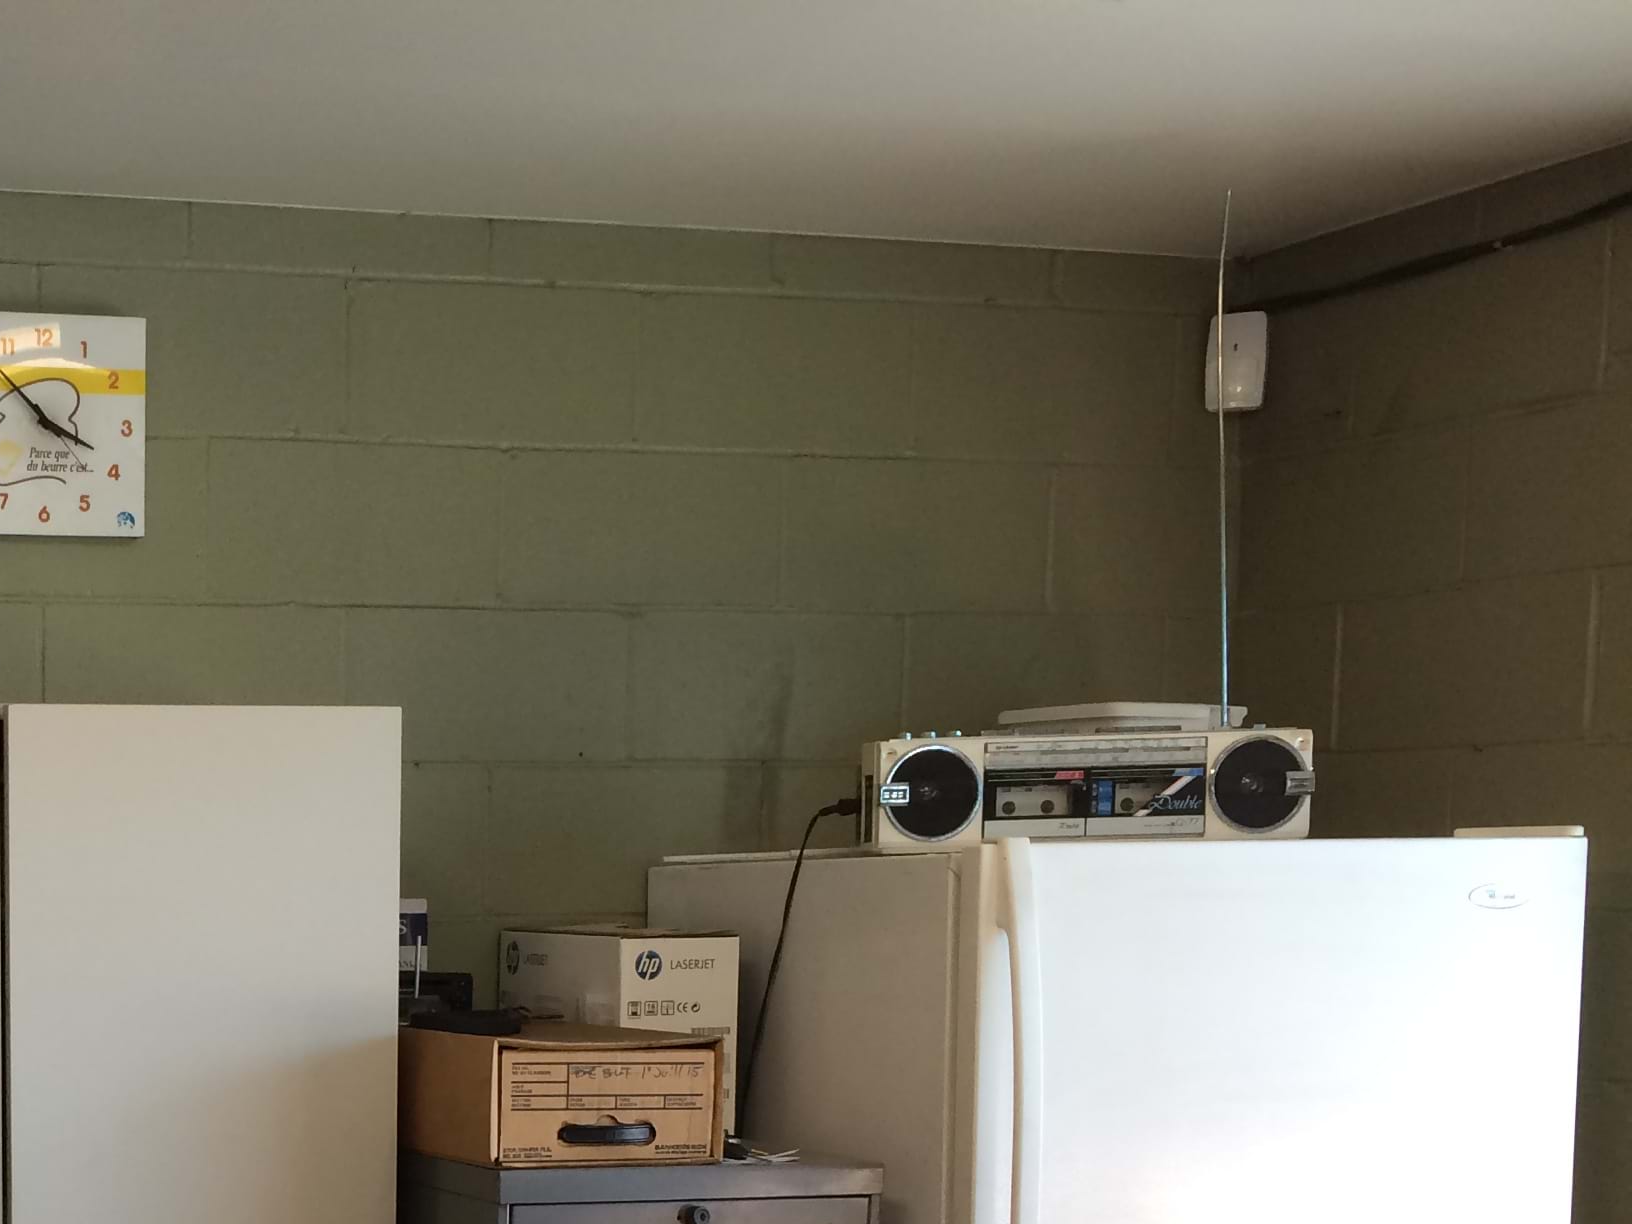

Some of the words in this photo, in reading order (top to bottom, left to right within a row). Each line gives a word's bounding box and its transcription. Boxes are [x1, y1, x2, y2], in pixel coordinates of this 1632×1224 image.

[0, 336, 15, 355] 11
[34, 328, 53, 347] 12
[80, 341, 88, 359] 1
[108, 371, 120, 389] 2
[121, 420, 133, 437] 3
[29, 447, 52, 459] Parce
[54, 450, 70, 462] que
[26, 460, 38, 472] du
[41, 460, 68, 472] beurre
[107, 464, 121, 481] 4
[79, 494, 91, 512] 5
[38, 506, 51, 523] 6
[1150, 794, 1202, 810] Double
[636, 951, 661, 980] hp
[669, 958, 716, 971] LASERJET
